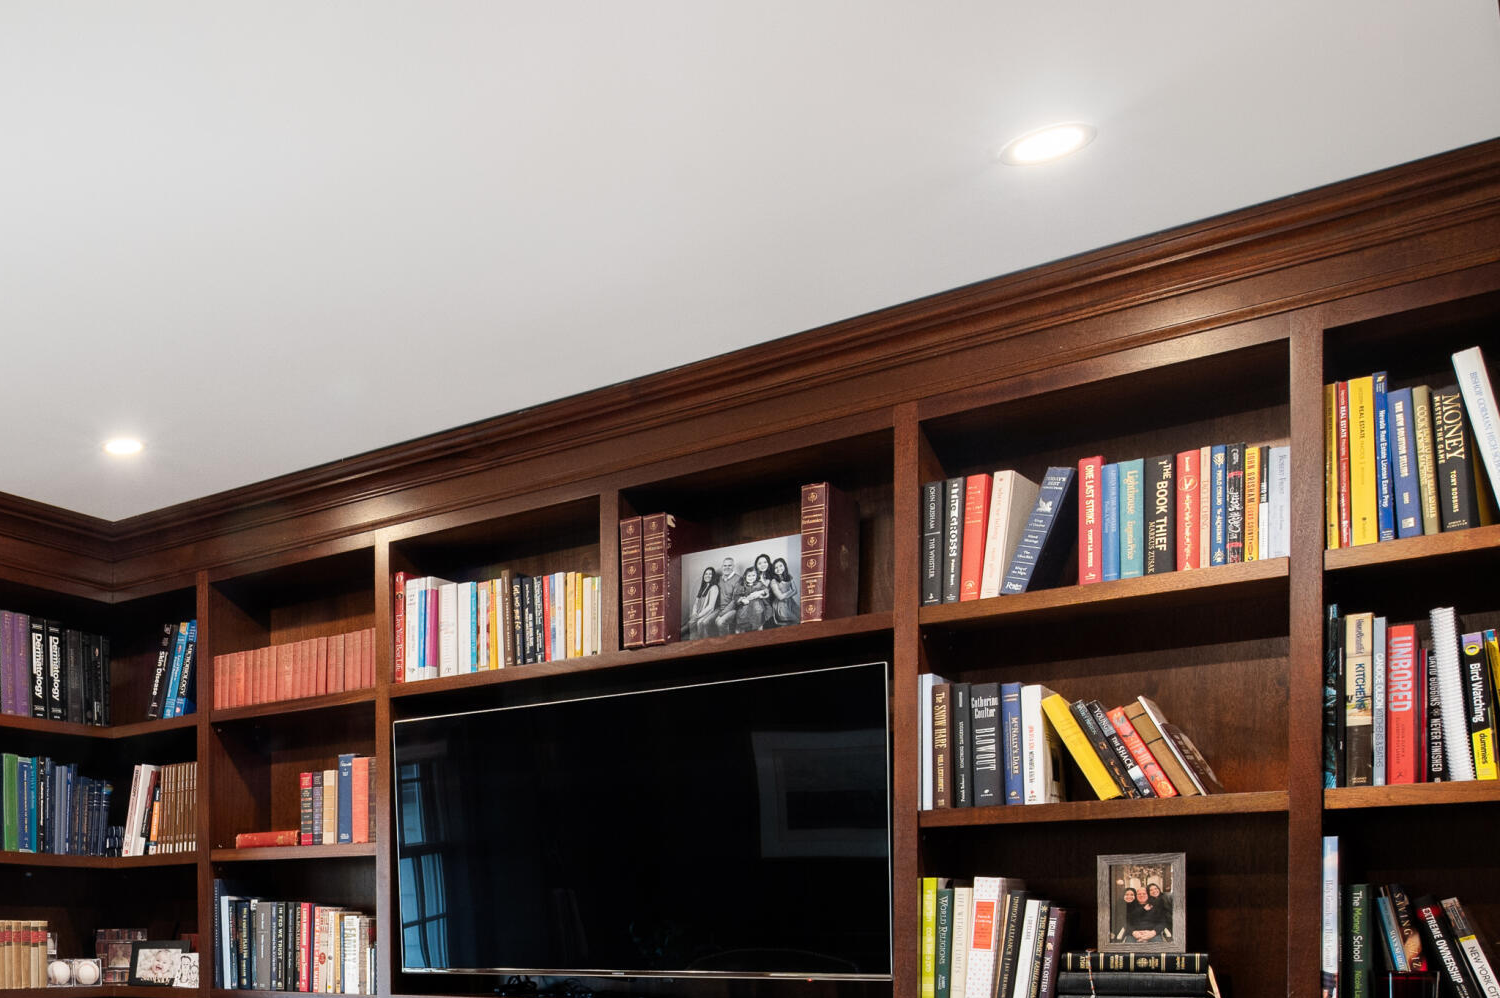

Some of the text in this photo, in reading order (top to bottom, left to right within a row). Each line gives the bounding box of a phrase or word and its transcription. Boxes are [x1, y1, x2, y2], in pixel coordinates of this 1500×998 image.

[1442, 393, 1465, 459] MONEY
[1247, 452, 1255, 469] JOHN
[1438, 444, 1446, 464] GAME
[1085, 465, 1094, 525] ONE LAST STRIKE
[1123, 470, 1139, 515] Lighthouse
[1247, 471, 1255, 504] GRISHAM
[1450, 470, 1458, 486] TONY
[1155, 463, 1172, 551] THE BOOK THIEF
[1148, 521, 1156, 549] MARKUS
[35, 634, 43, 699] Dermatology
[52, 636, 60, 701] Dermatology
[152, 668, 162, 696] Disease
[1356, 663, 1365, 710] KITCHENS
[1389, 636, 1412, 712] UNBORED
[975, 707, 996, 719] Coulter
[1470, 663, 1485, 723] Bird Watching
[934, 692, 946, 749] The SNOW HARE
[1094, 707, 1108, 729] YOUNG
[975, 727, 996, 771] BLOWOUT
[1116, 743, 1134, 769] SHACK
[1430, 718, 1443, 772] NEVER FINISHED
[1479, 733, 1488, 764] dummies
[278, 928, 282, 938] WE
[1352, 891, 1363, 962] The Money School
[1394, 892, 1413, 935] SAVING
[1422, 907, 1463, 984] EXTREME OWNERSHIP
[1468, 946, 1483, 964] NEW
[1477, 965, 1492, 985] YORK
